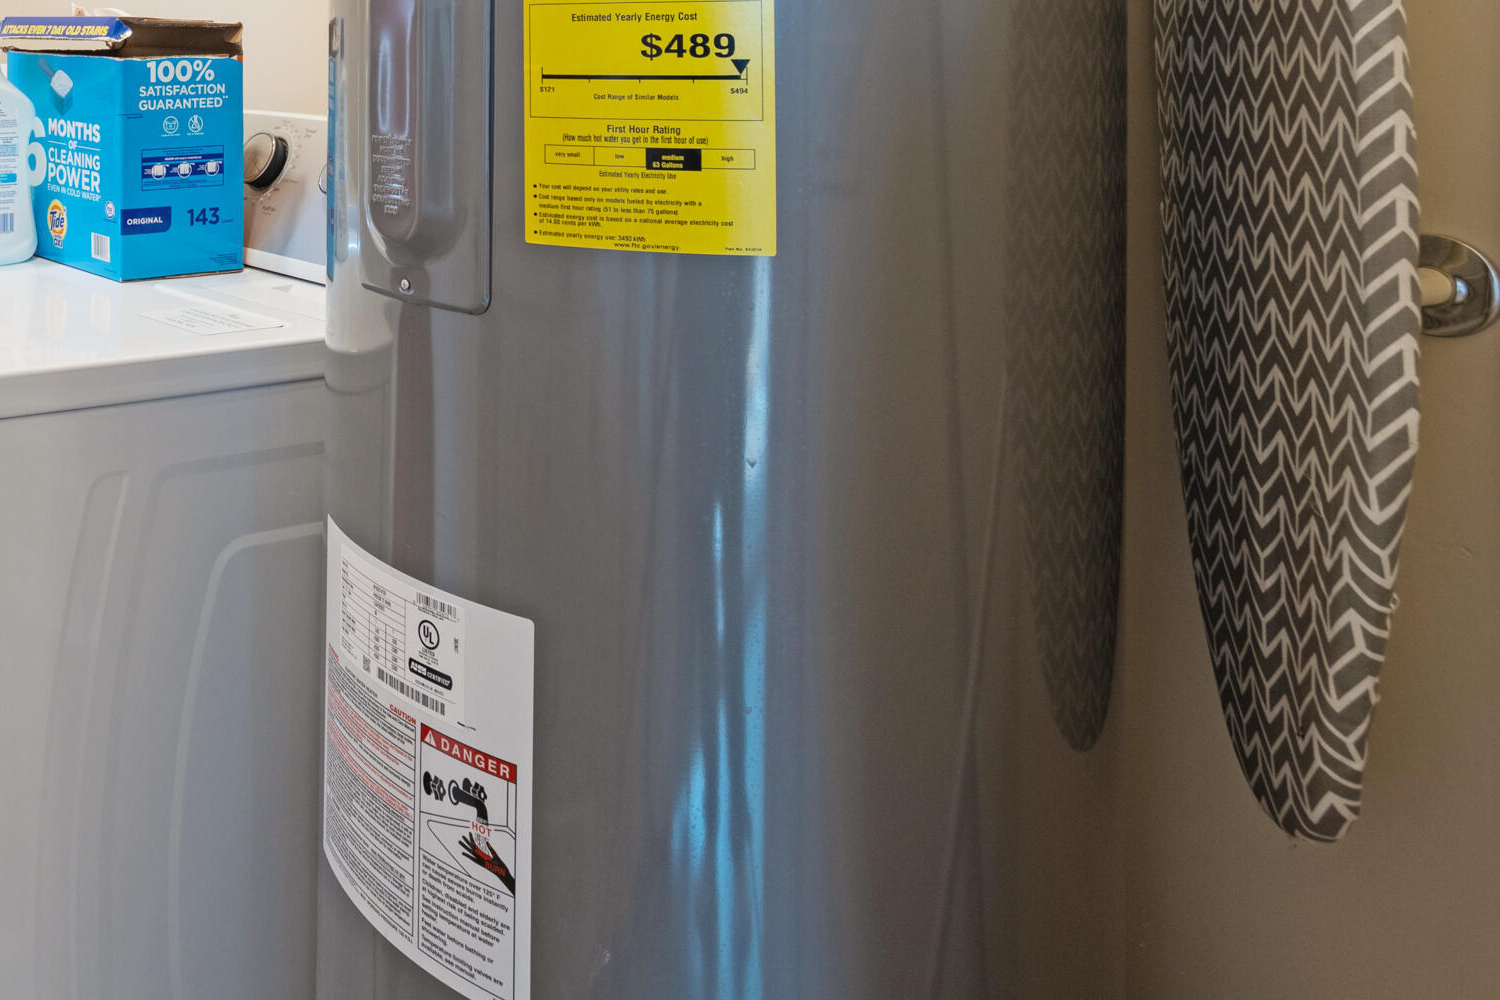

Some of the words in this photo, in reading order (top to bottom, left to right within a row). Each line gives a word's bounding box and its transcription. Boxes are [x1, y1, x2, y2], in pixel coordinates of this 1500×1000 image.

[571, 13, 612, 22] Estimated
[615, 13, 642, 23] Yearly
[645, 12, 675, 23] Energy
[678, 12, 698, 21] Cost
[2, 24, 28, 35] ATTACKS
[28, 24, 46, 35] EVEN
[51, 25, 67, 36] DAY
[65, 25, 81, 36] OLD
[81, 25, 109, 36] STAINS
[641, 33, 736, 61] $489
[146, 59, 215, 83] 100%
[139, 83, 225, 97] SATISFACTION
[593, 93, 607, 101] Cost
[608, 93, 626, 102] Range
[627, 93, 633, 101] of
[635, 93, 655, 101] Similar
[657, 94, 679, 102] Models
[730, 87, 748, 95] $494
[139, 97, 223, 111] GUARANTEED
[48, 117, 100, 143] MONTHS
[606, 124, 626, 134] First
[629, 125, 649, 134] Hour
[653, 125, 681, 135] Rating
[68, 140, 78, 150] OF
[562, 133, 575, 143] (How
[577, 134, 592, 142] much
[593, 134, 602, 143] hot
[604, 135, 619, 143] water
[620, 136, 631, 144] you
[632, 135, 642, 145] get
[650, 135, 659, 144] the
[660, 136, 672, 144] first
[674, 136, 687, 145] hour
[688, 136, 695, 144] of
[696, 137, 708, 146] use)
[28, 116, 47, 187] 6
[48, 147, 100, 171] CLEANING
[48, 162, 100, 194] POWER
[624, 171, 639, 179] Yearly
[641, 172, 665, 180] Electricity
[47, 183, 60, 193] EVEN
[61, 186, 67, 195] IN
[67, 187, 81, 198] COLD
[50, 210, 65, 231] Tide
[126, 216, 163, 226] ORIGINAL
[187, 207, 220, 227] 143
[389, 704, 416, 725] CAUTION
[440, 738, 511, 779] DANGER
[471, 821, 492, 838] HOT
[422, 854, 436, 866] Water
[436, 863, 468, 885] temperature
[468, 881, 482, 891] over
[484, 861, 506, 877] BURN
[422, 862, 431, 871] can
[432, 868, 447, 880] cause
[447, 877, 465, 891] severe
[465, 887, 482, 900] burns
[483, 896, 509, 913] instantly
[442, 881, 455, 892] from
[446, 901, 457, 910] risk
[467, 905, 479, 915] and
[479, 912, 499, 927] elderly
[500, 922, 511, 931] are
[460, 918, 480, 933] manual
[480, 928, 500, 943] before
[477, 935, 494, 947] water
